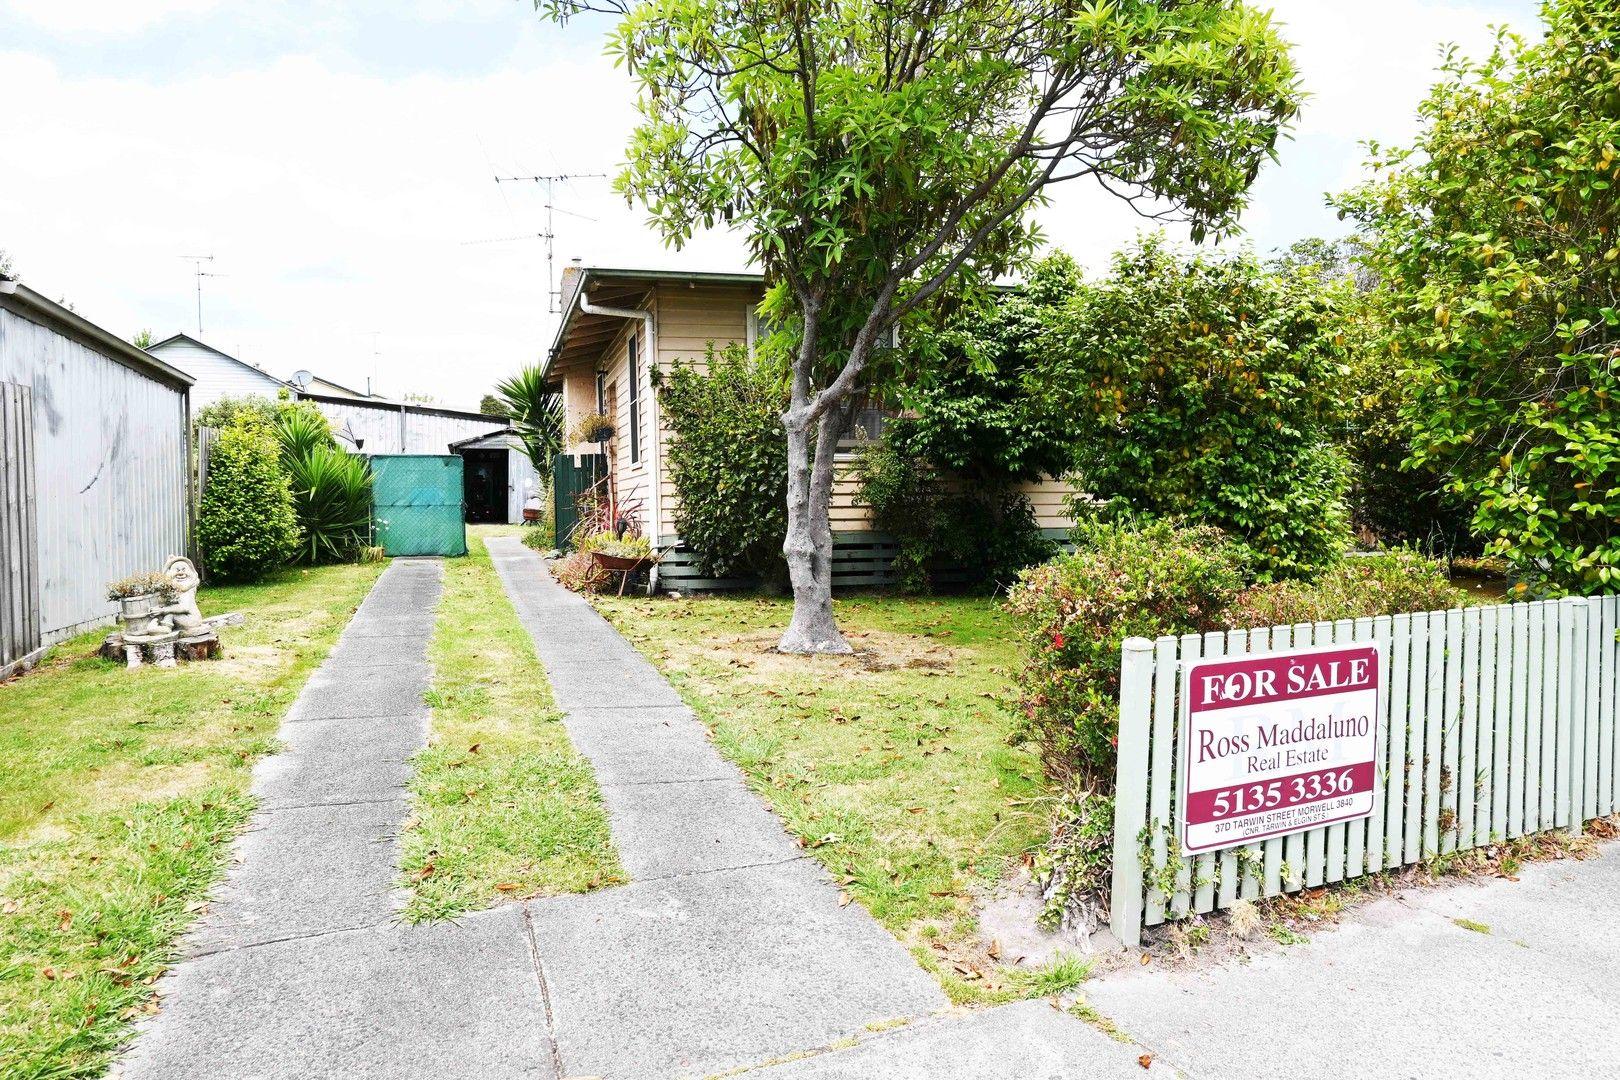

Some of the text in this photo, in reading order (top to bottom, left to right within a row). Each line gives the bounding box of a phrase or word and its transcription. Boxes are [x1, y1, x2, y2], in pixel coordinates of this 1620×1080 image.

[1201, 660, 1370, 705] FOR SALE
[1197, 728, 1250, 763] Ross
[1257, 714, 1369, 750] Maddaluno
[1248, 748, 1328, 774] Real Estate
[1212, 768, 1353, 817] 5135 3336
[1233, 815, 1264, 830] TARWIN
[1266, 809, 1295, 825] STREET
[1297, 801, 1334, 819] MORWELL
[1336, 798, 1354, 810] 3840
[1262, 821, 1285, 834] TARWIN
